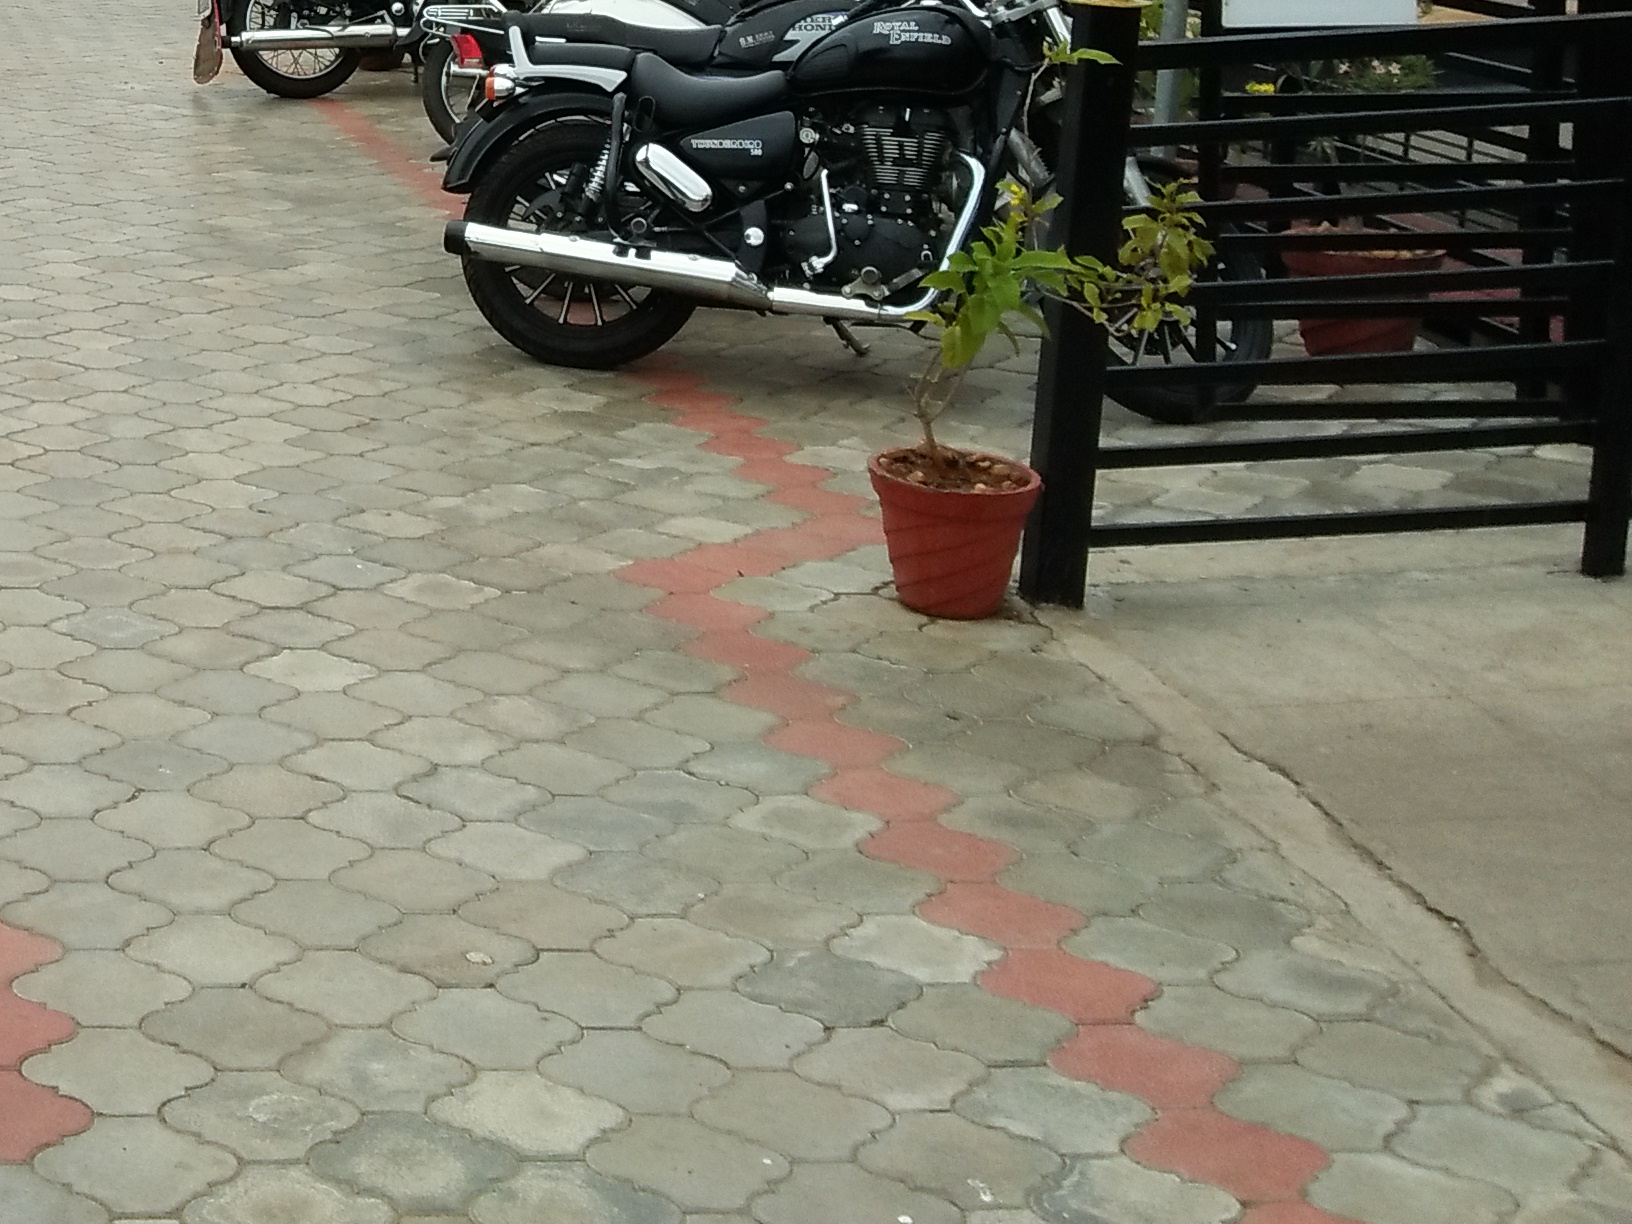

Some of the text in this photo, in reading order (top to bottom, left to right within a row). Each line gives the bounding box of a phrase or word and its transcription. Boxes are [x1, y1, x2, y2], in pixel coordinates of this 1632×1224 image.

[873, 20, 919, 33] ROYAL
[889, 30, 952, 46] ENFIELD
[690, 139, 763, 149] THUNDERBIRD
